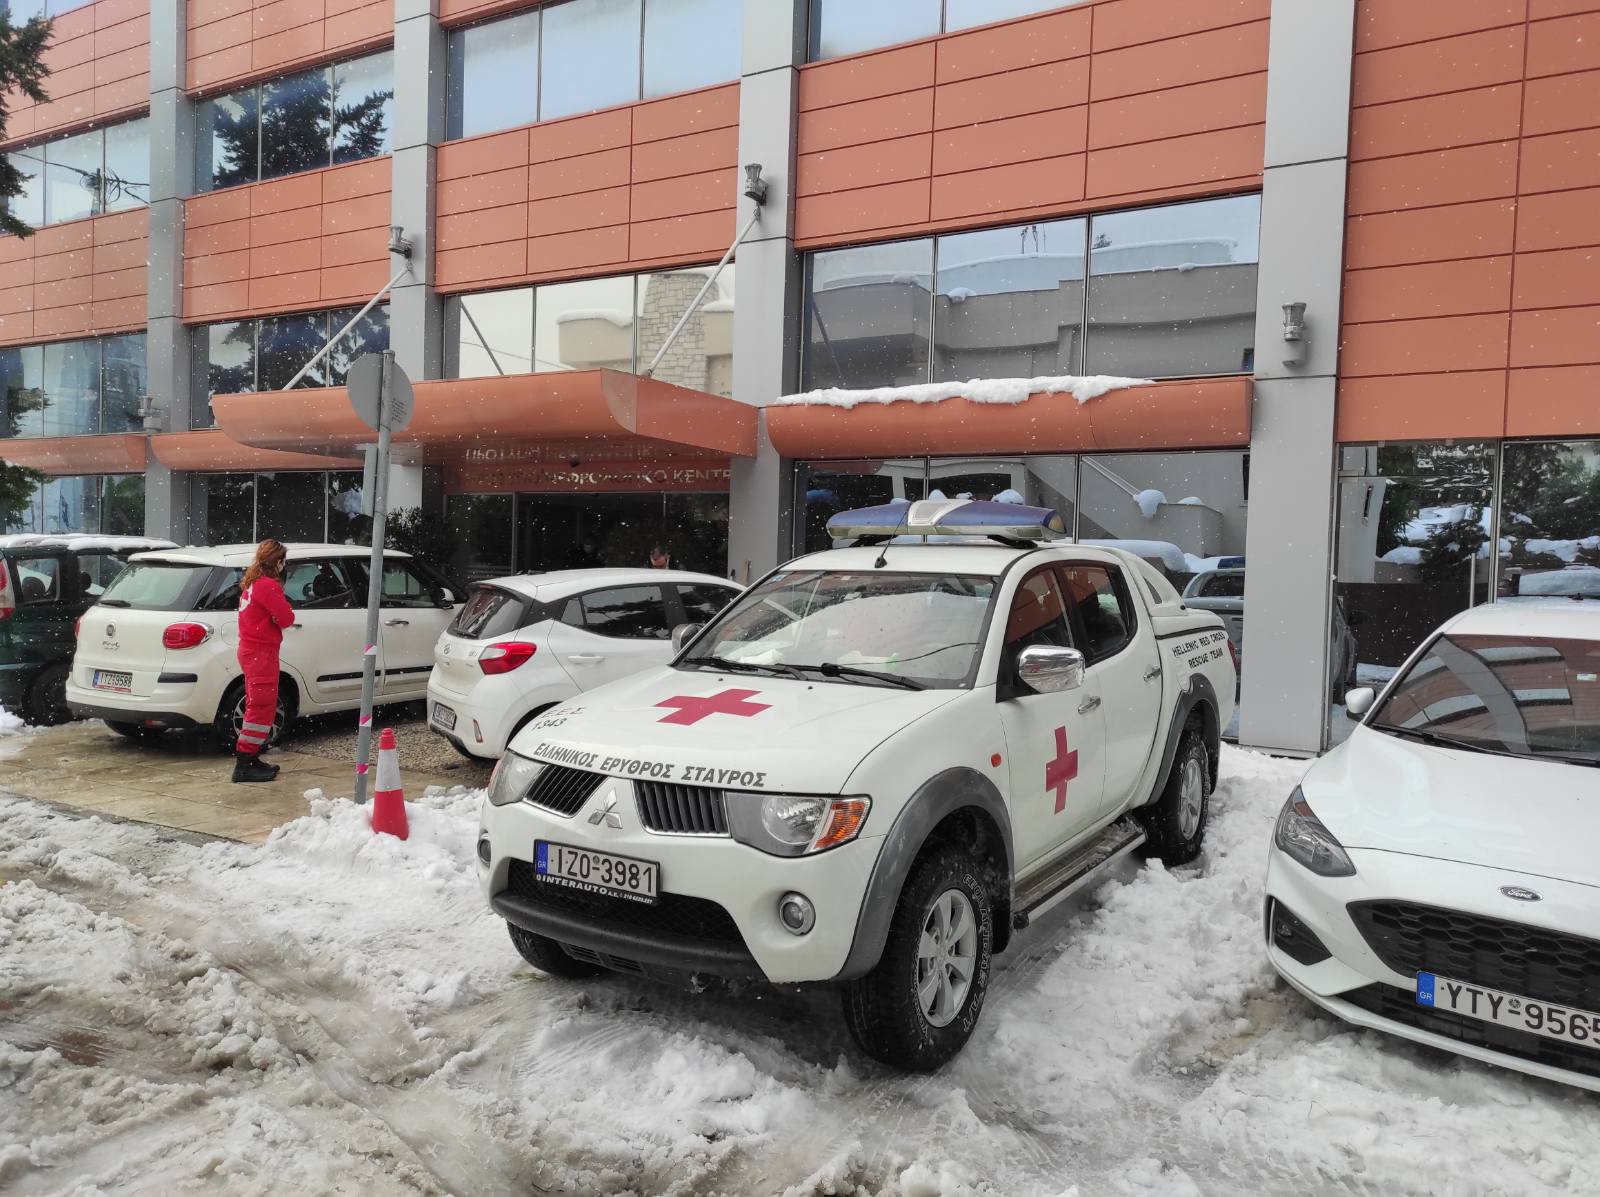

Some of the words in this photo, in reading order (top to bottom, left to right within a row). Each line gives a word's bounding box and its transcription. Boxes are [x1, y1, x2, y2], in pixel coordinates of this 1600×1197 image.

[1172, 640, 1199, 657] HELLENIC
[1199, 636, 1211, 647] RED
[1188, 653, 1209, 669] RESCUE
[1210, 648, 1223, 660] TEAM
[532, 718, 567, 731] 1343
[533, 742, 599, 769] ΕΛΛΗΝΙΚΟΣ
[600, 756, 675, 779] ΕΡΥΘΡΟΣ
[681, 765, 767, 788] ΣΤΑΥΡΟΣ
[542, 874, 608, 896] INTERAUTO
[1419, 991, 1433, 1001] GR
